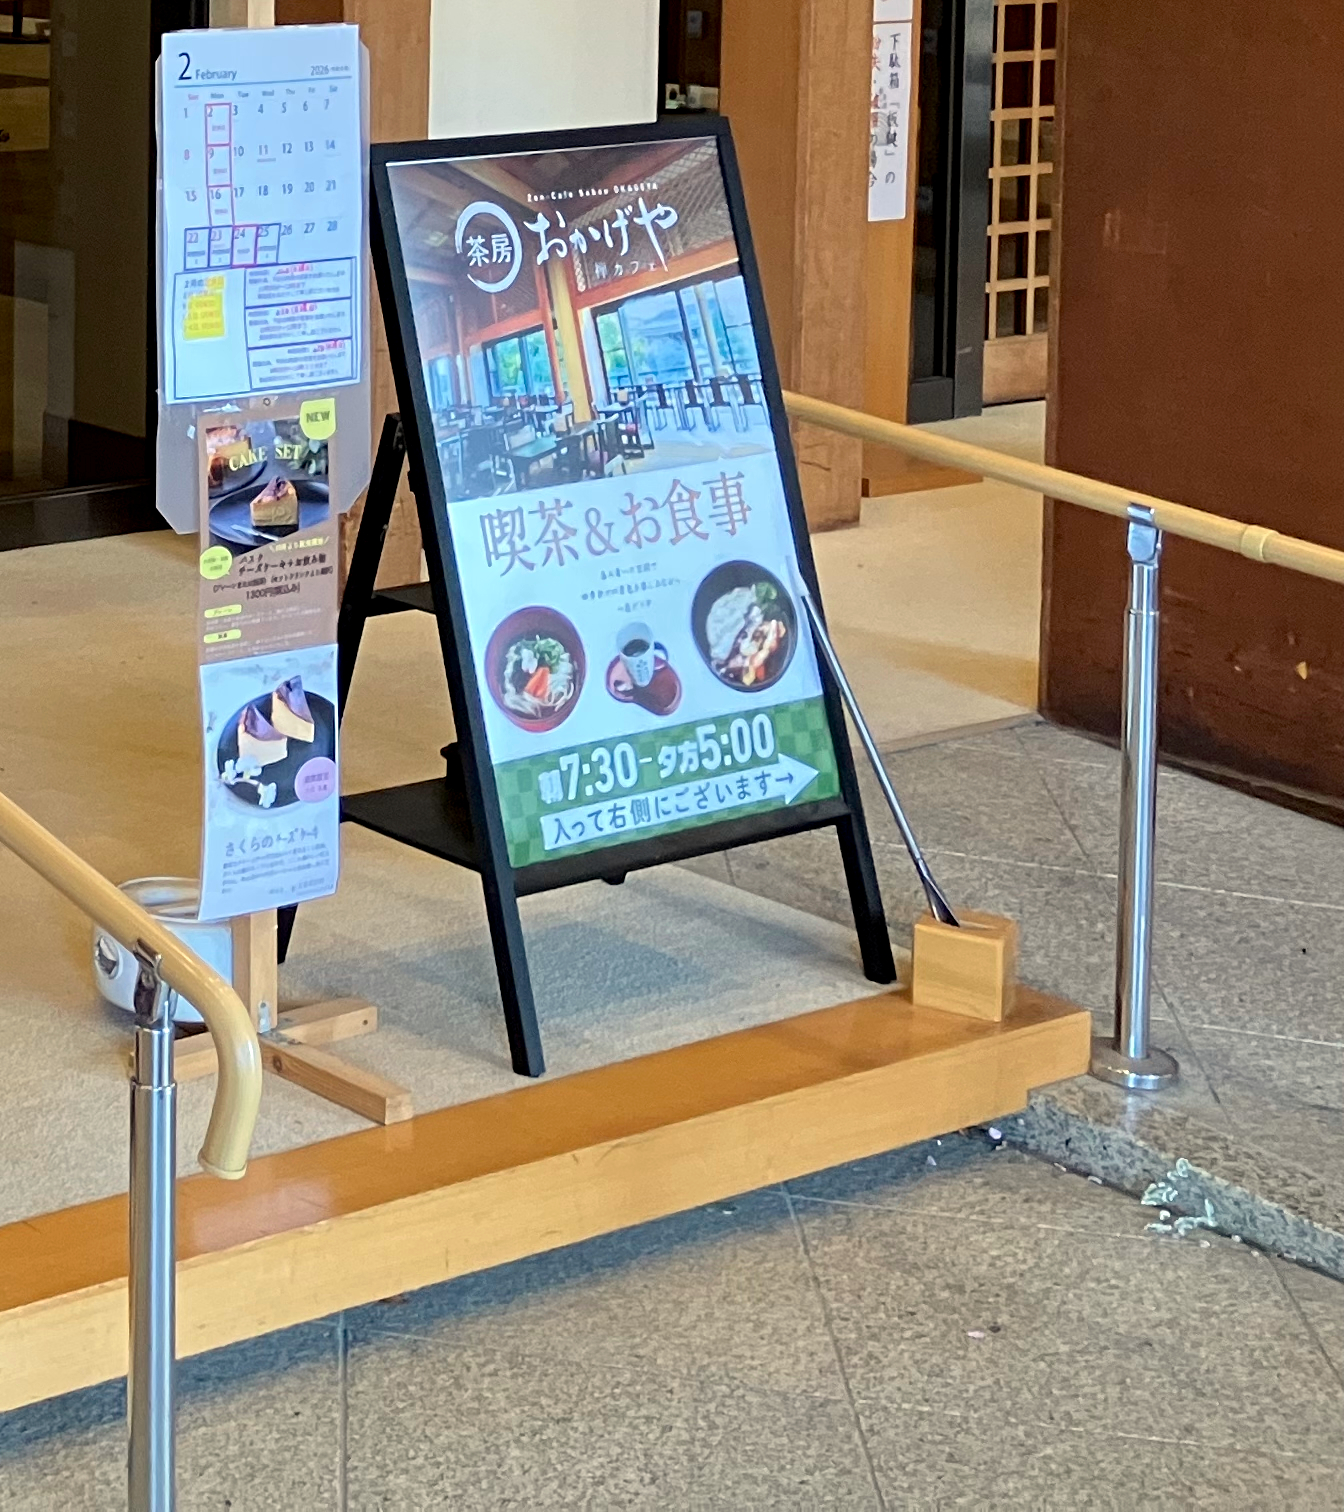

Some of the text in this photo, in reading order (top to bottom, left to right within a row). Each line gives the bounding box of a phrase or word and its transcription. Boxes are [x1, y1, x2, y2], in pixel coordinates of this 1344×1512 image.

[178, 52, 237, 82] 2 February
[466, 233, 512, 267] 茶房
[524, 196, 679, 272] おかげや
[306, 411, 330, 423] NEW
[228, 444, 302, 471] CAKE SET
[479, 471, 752, 577] 喫茶&お食事
